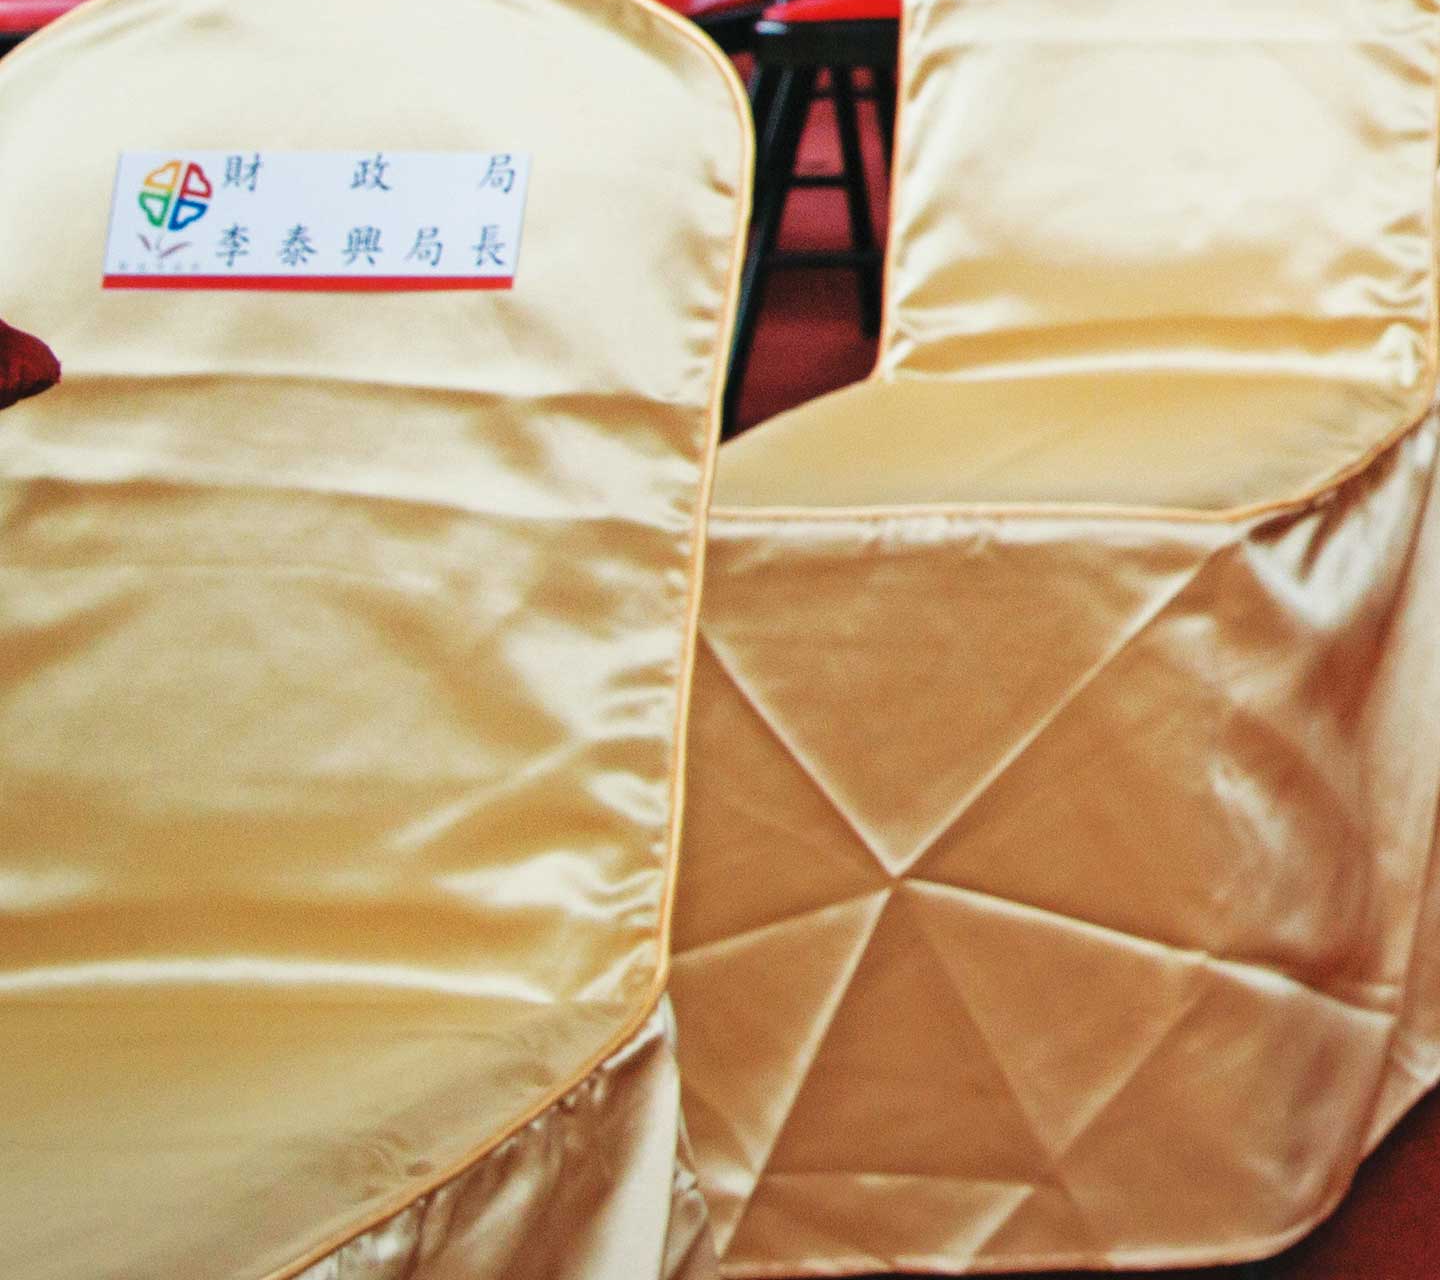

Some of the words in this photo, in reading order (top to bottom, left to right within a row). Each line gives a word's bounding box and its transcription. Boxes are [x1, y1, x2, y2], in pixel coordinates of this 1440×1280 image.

[222, 151, 518, 195] 財政局
[214, 221, 508, 268] 李泰興局長
